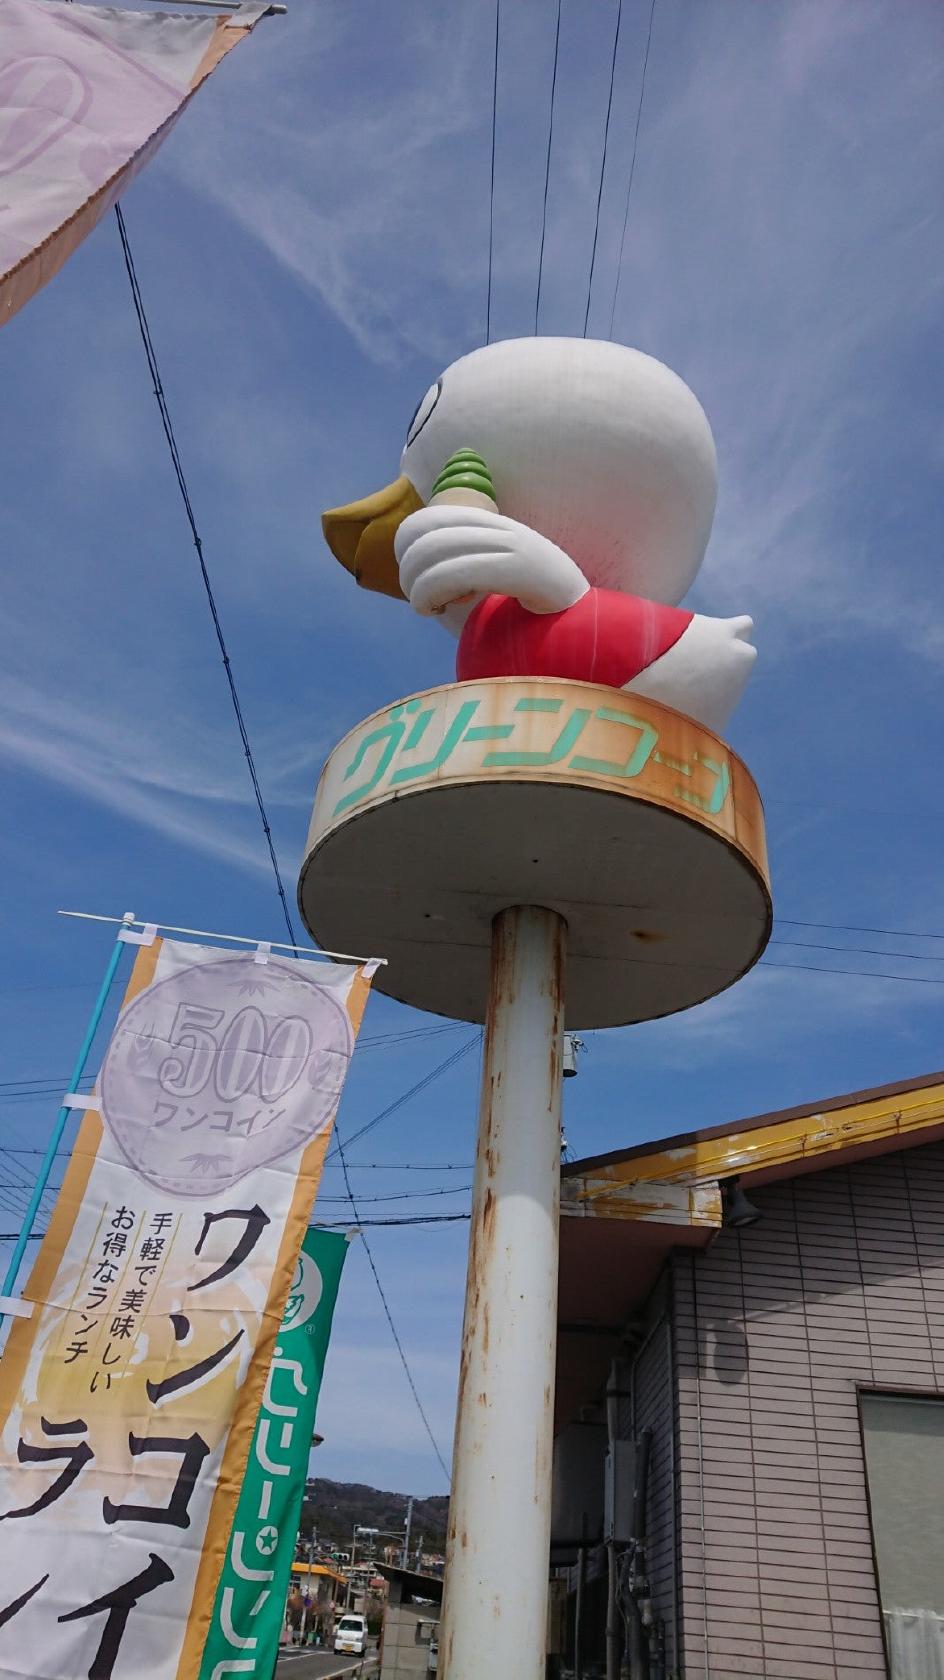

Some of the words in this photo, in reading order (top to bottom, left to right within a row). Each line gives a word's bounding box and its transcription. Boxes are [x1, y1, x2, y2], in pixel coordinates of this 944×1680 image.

[159, 1002, 313, 1104] 500
[153, 1101, 286, 1136] ワンコイン
[64, 1206, 136, 1364] お得なランチ
[90, 1212, 173, 1393] 手軽で美味しい
